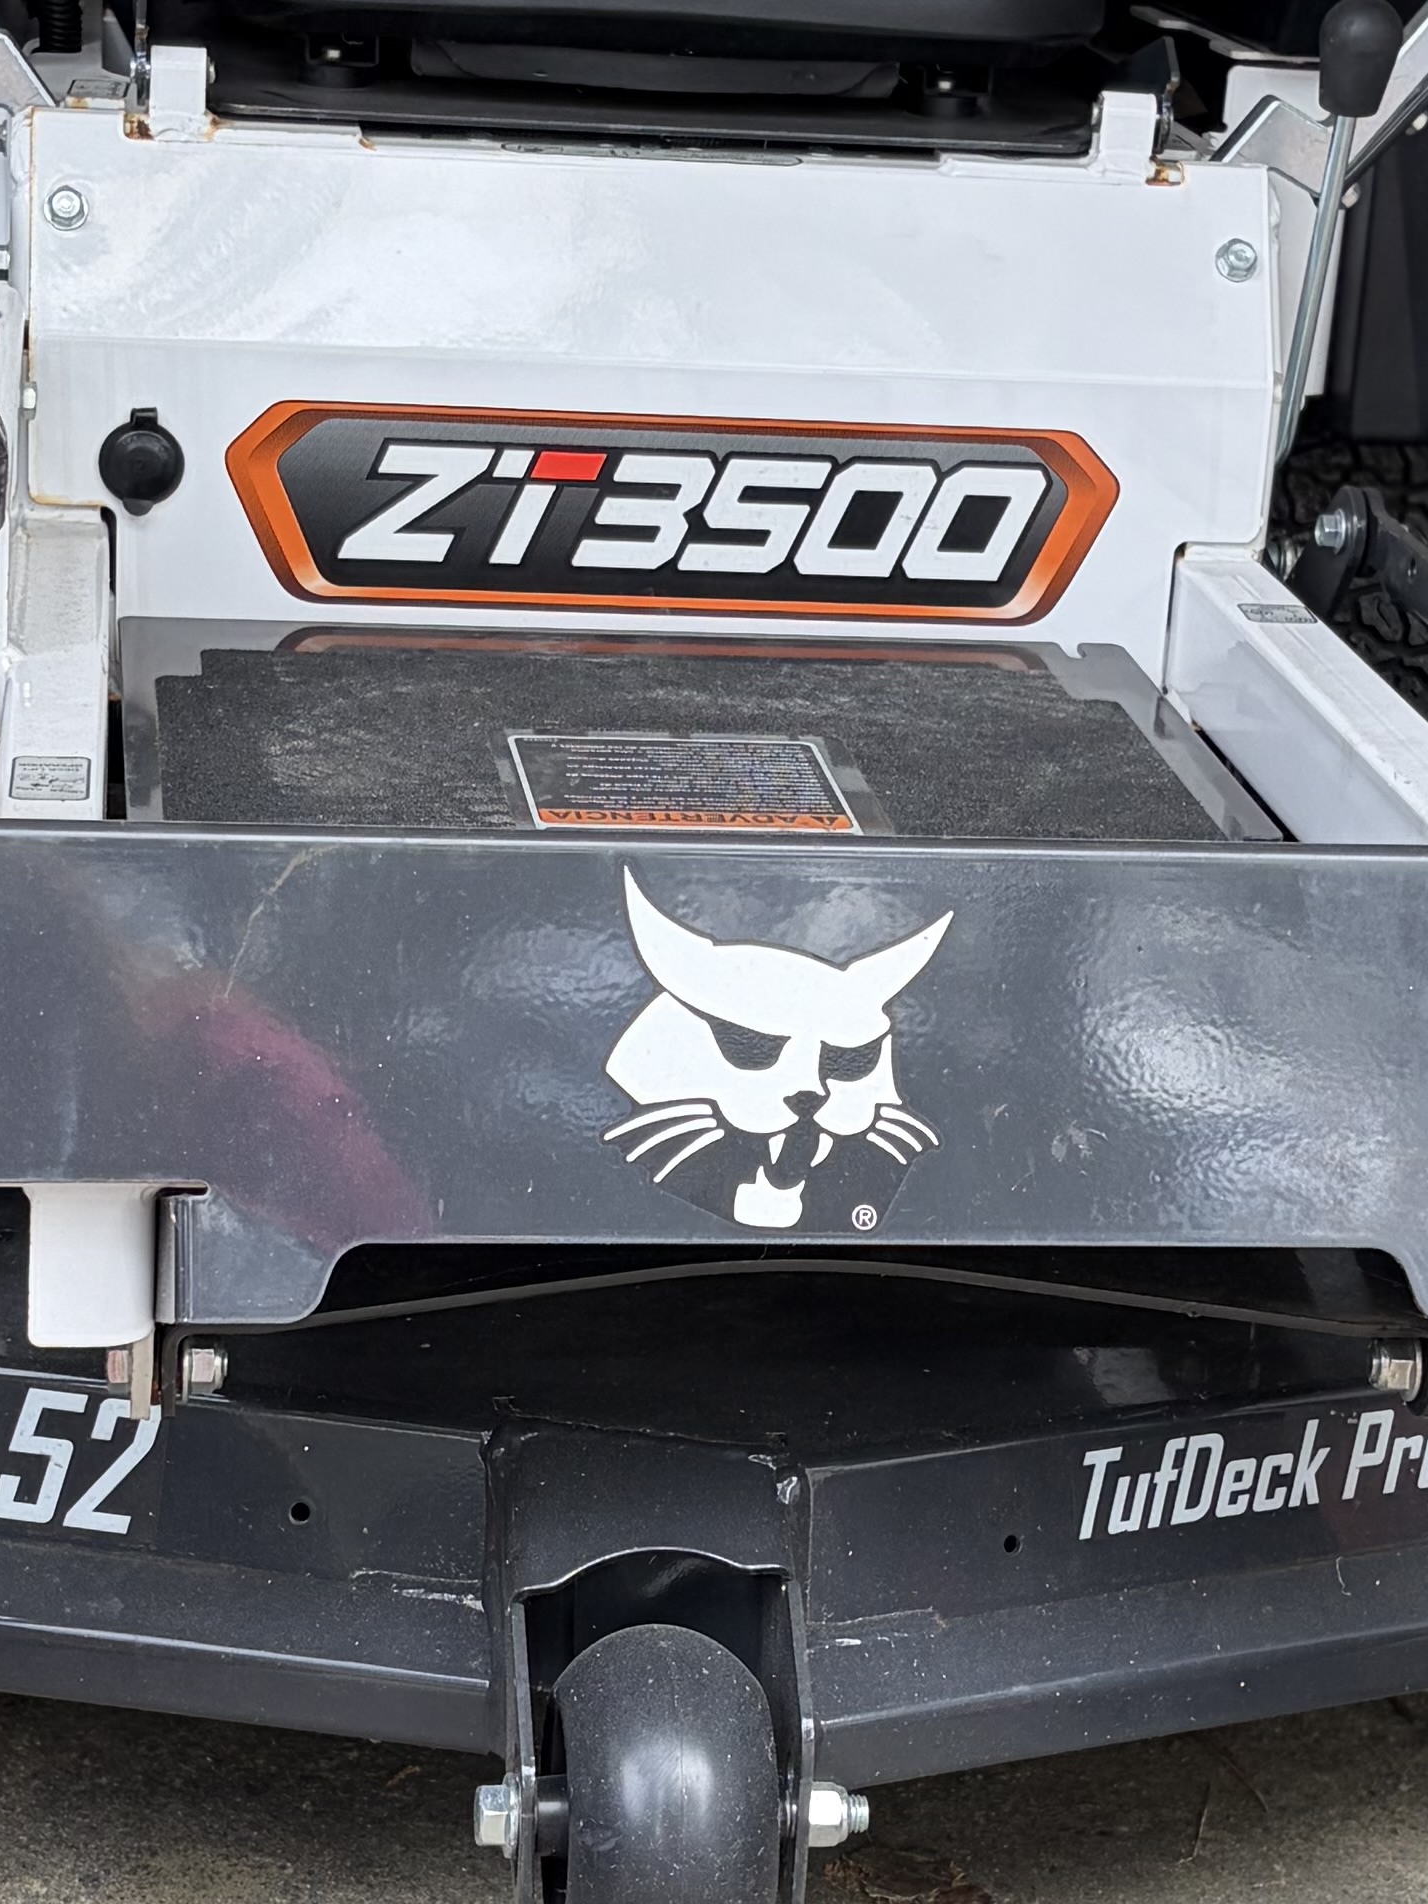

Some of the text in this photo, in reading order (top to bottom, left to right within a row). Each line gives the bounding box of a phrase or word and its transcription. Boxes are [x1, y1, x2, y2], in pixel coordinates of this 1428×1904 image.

[337, 441, 1049, 581] ZT3500
[549, 809, 798, 824] ADVERTENCIA
[1078, 1418, 1332, 1541] TufDeck
